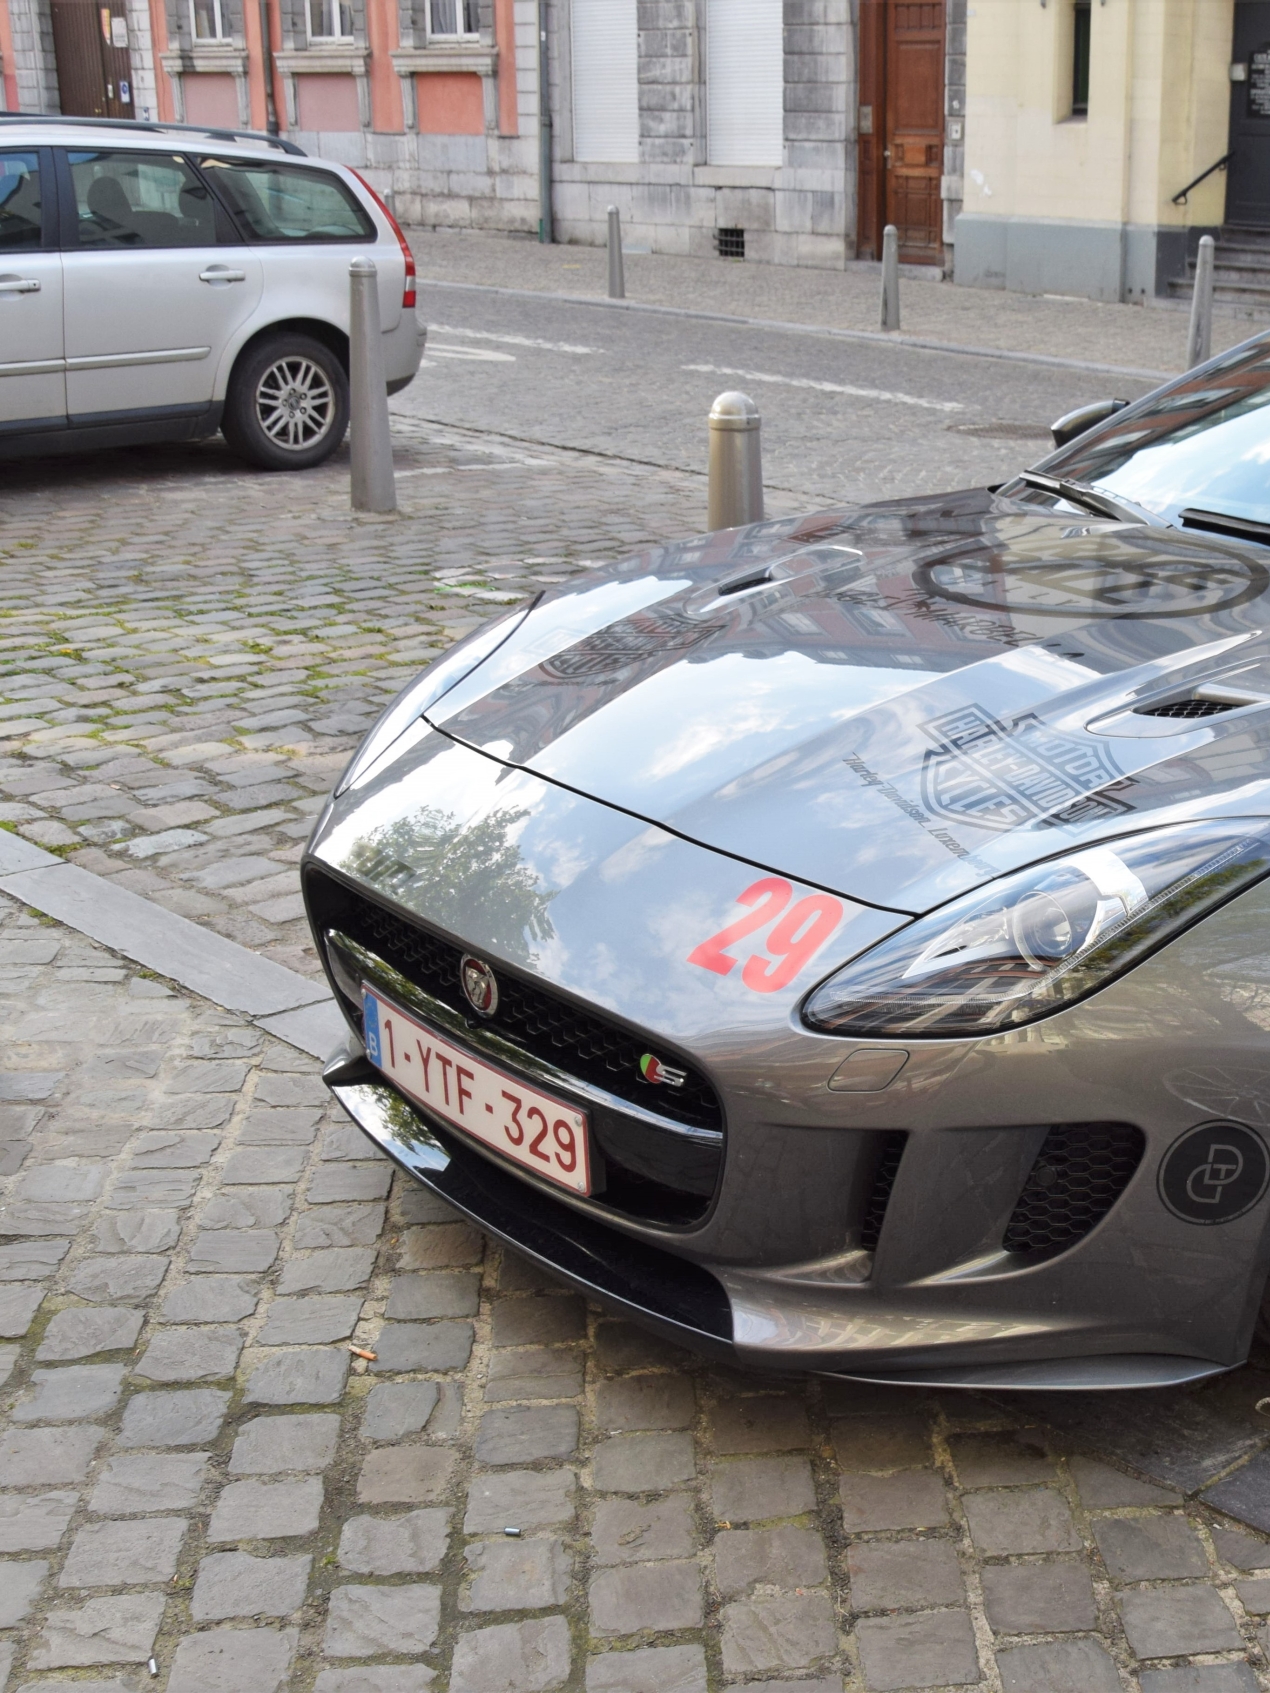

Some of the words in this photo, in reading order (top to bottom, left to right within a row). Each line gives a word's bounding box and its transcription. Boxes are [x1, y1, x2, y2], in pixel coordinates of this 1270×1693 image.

[936, 759, 1029, 824] CYCLES
[941, 713, 1117, 825] HARLEY-DAVIDSON
[1019, 722, 1112, 789] MOTOR
[686, 877, 844, 994] 29
[368, 1032, 378, 1056] B
[384, 1019, 577, 1173] 1-YTF-329
